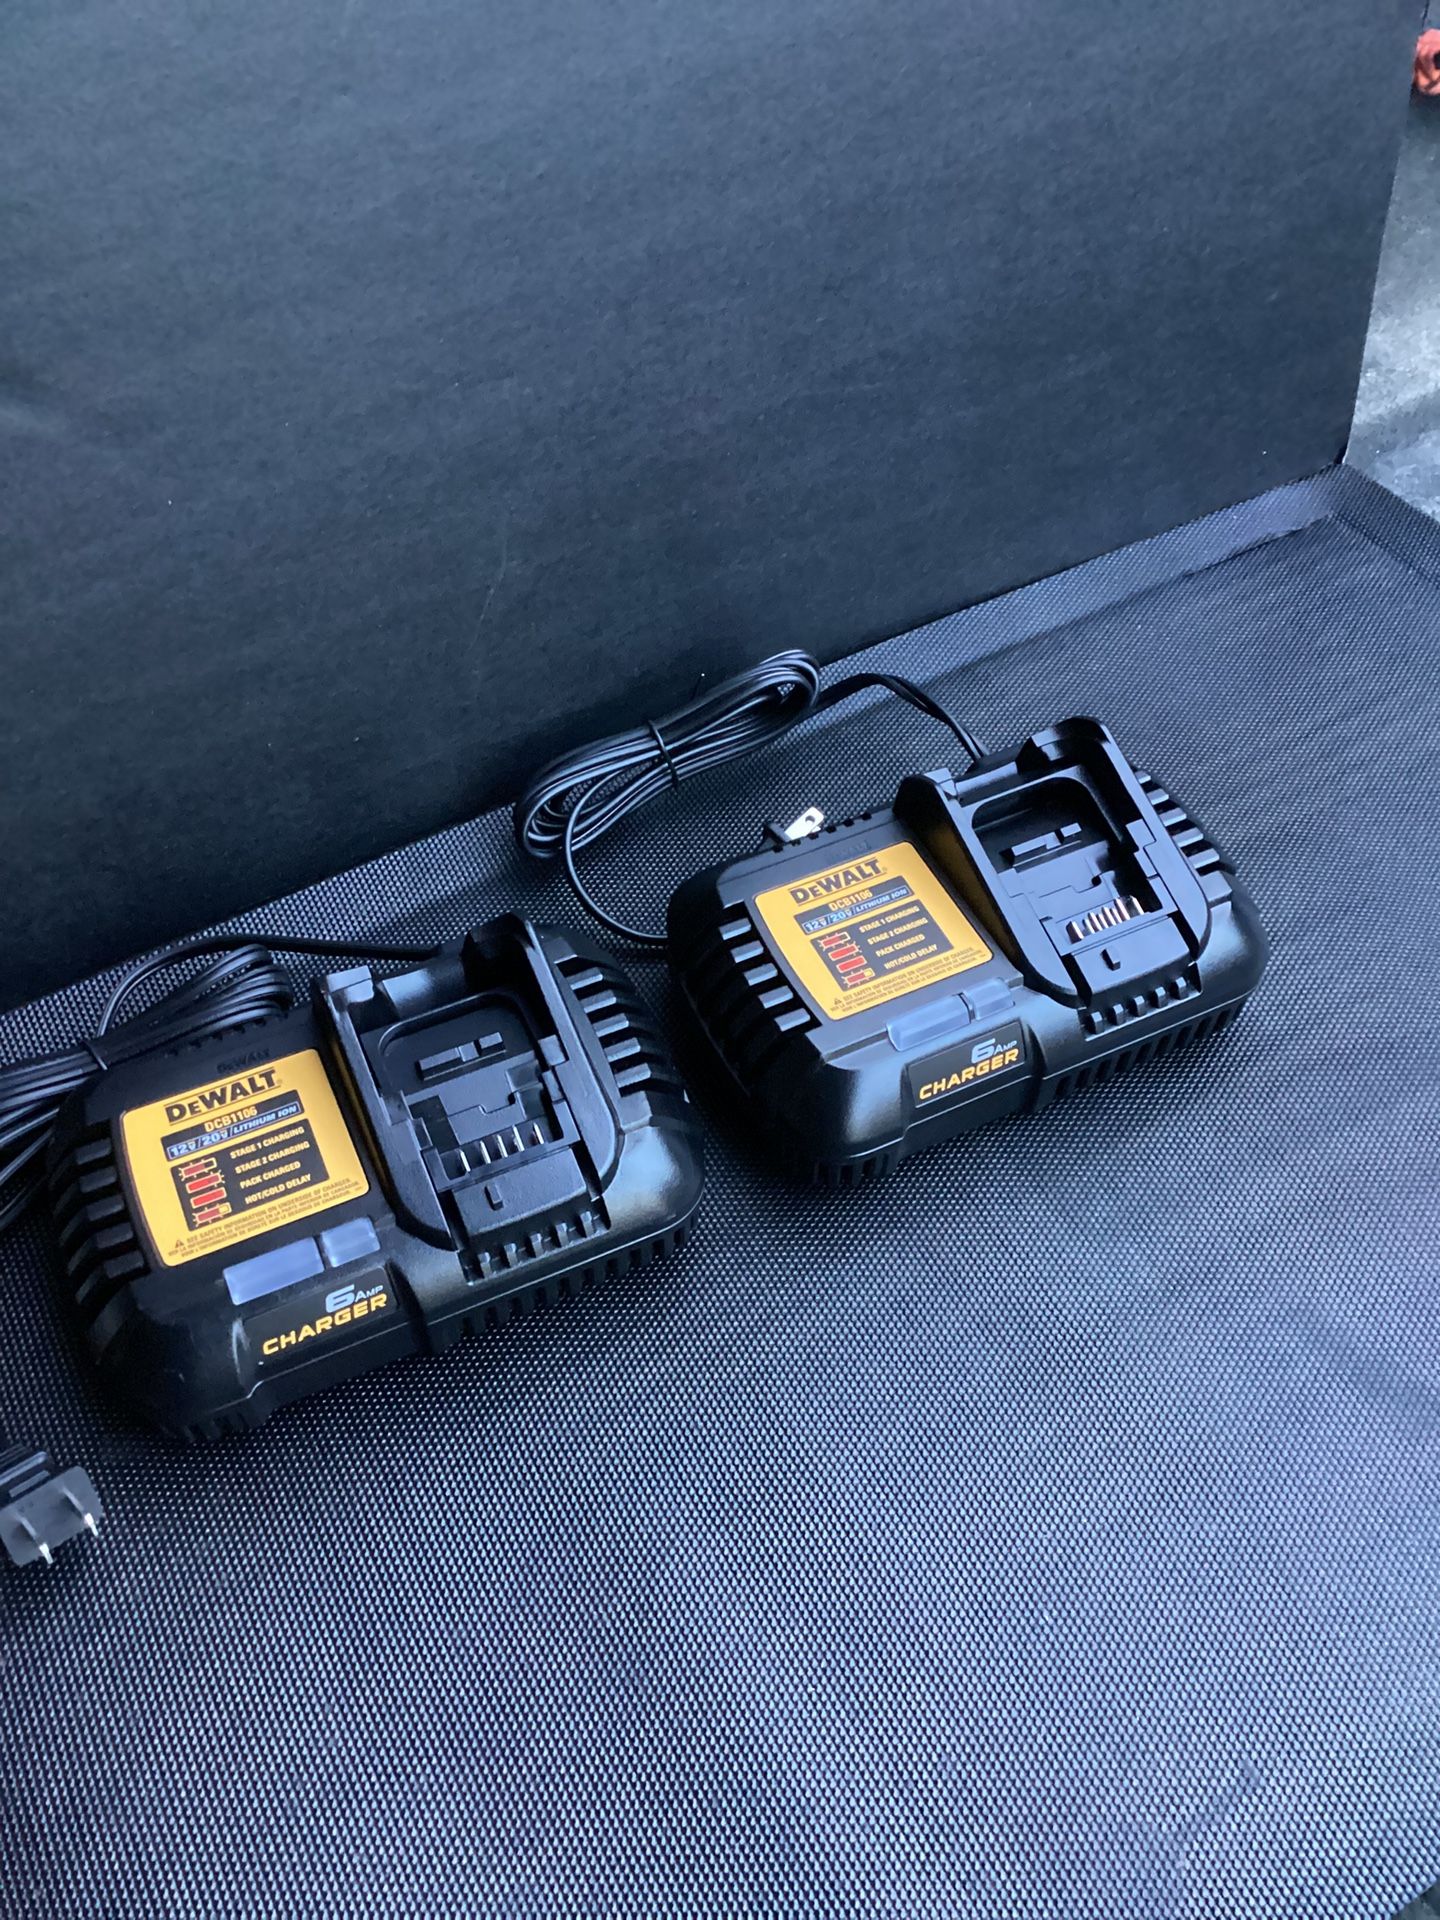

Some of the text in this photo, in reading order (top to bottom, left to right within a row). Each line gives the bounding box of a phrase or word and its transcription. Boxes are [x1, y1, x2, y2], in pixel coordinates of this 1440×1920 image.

[829, 889, 873, 911] DCB1106
[891, 888, 908, 899] ION
[859, 919, 881, 933] STAGE
[885, 905, 920, 923] CHARGING
[867, 931, 889, 945] STAGE
[893, 917, 928, 935] CHARGING
[875, 933, 925, 957] PACK CHARGED
[884, 943, 938, 970] HOT/COLD DELAY
[919, 1048, 1019, 1100] CHARGER
[204, 1106, 258, 1132] DCB1106
[277, 1105, 298, 1118] ION
[230, 1144, 257, 1159] STAGE
[262, 1126, 305, 1147] CHARGING
[234, 1158, 262, 1174] STAGE
[267, 1141, 310, 1161] CHARGING
[240, 1161, 301, 1189] PACK CHARGED
[245, 1173, 311, 1204] HOT/COLD DELAY
[262, 1293, 388, 1355] CHARGER
